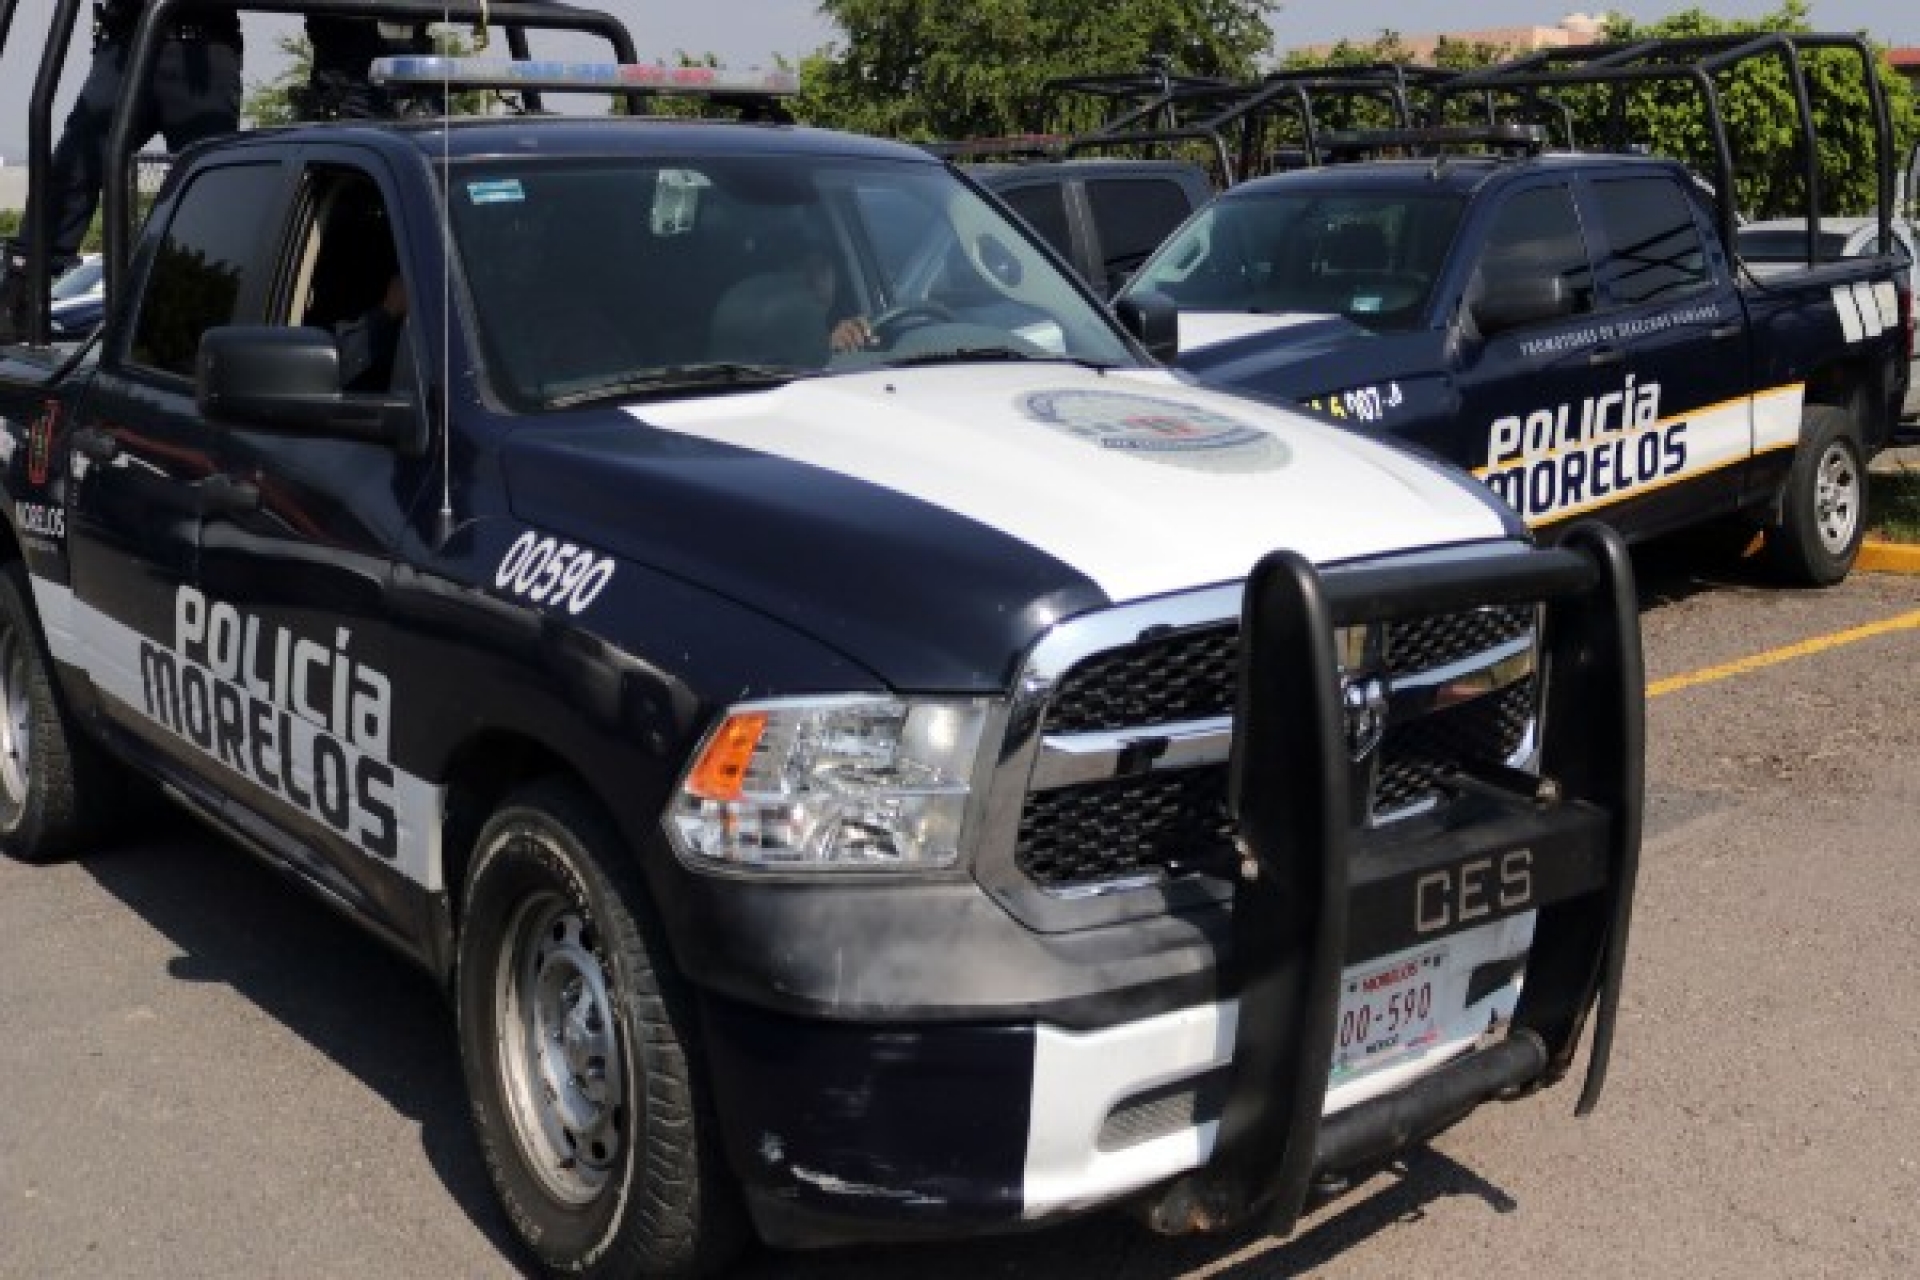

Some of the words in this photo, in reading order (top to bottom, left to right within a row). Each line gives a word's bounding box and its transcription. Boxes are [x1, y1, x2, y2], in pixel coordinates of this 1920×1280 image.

[496, 529, 616, 615] 00590
[140, 638, 399, 859] MORELOS
[1415, 847, 1534, 933] CES
[1340, 982, 1432, 1048] 00-590
